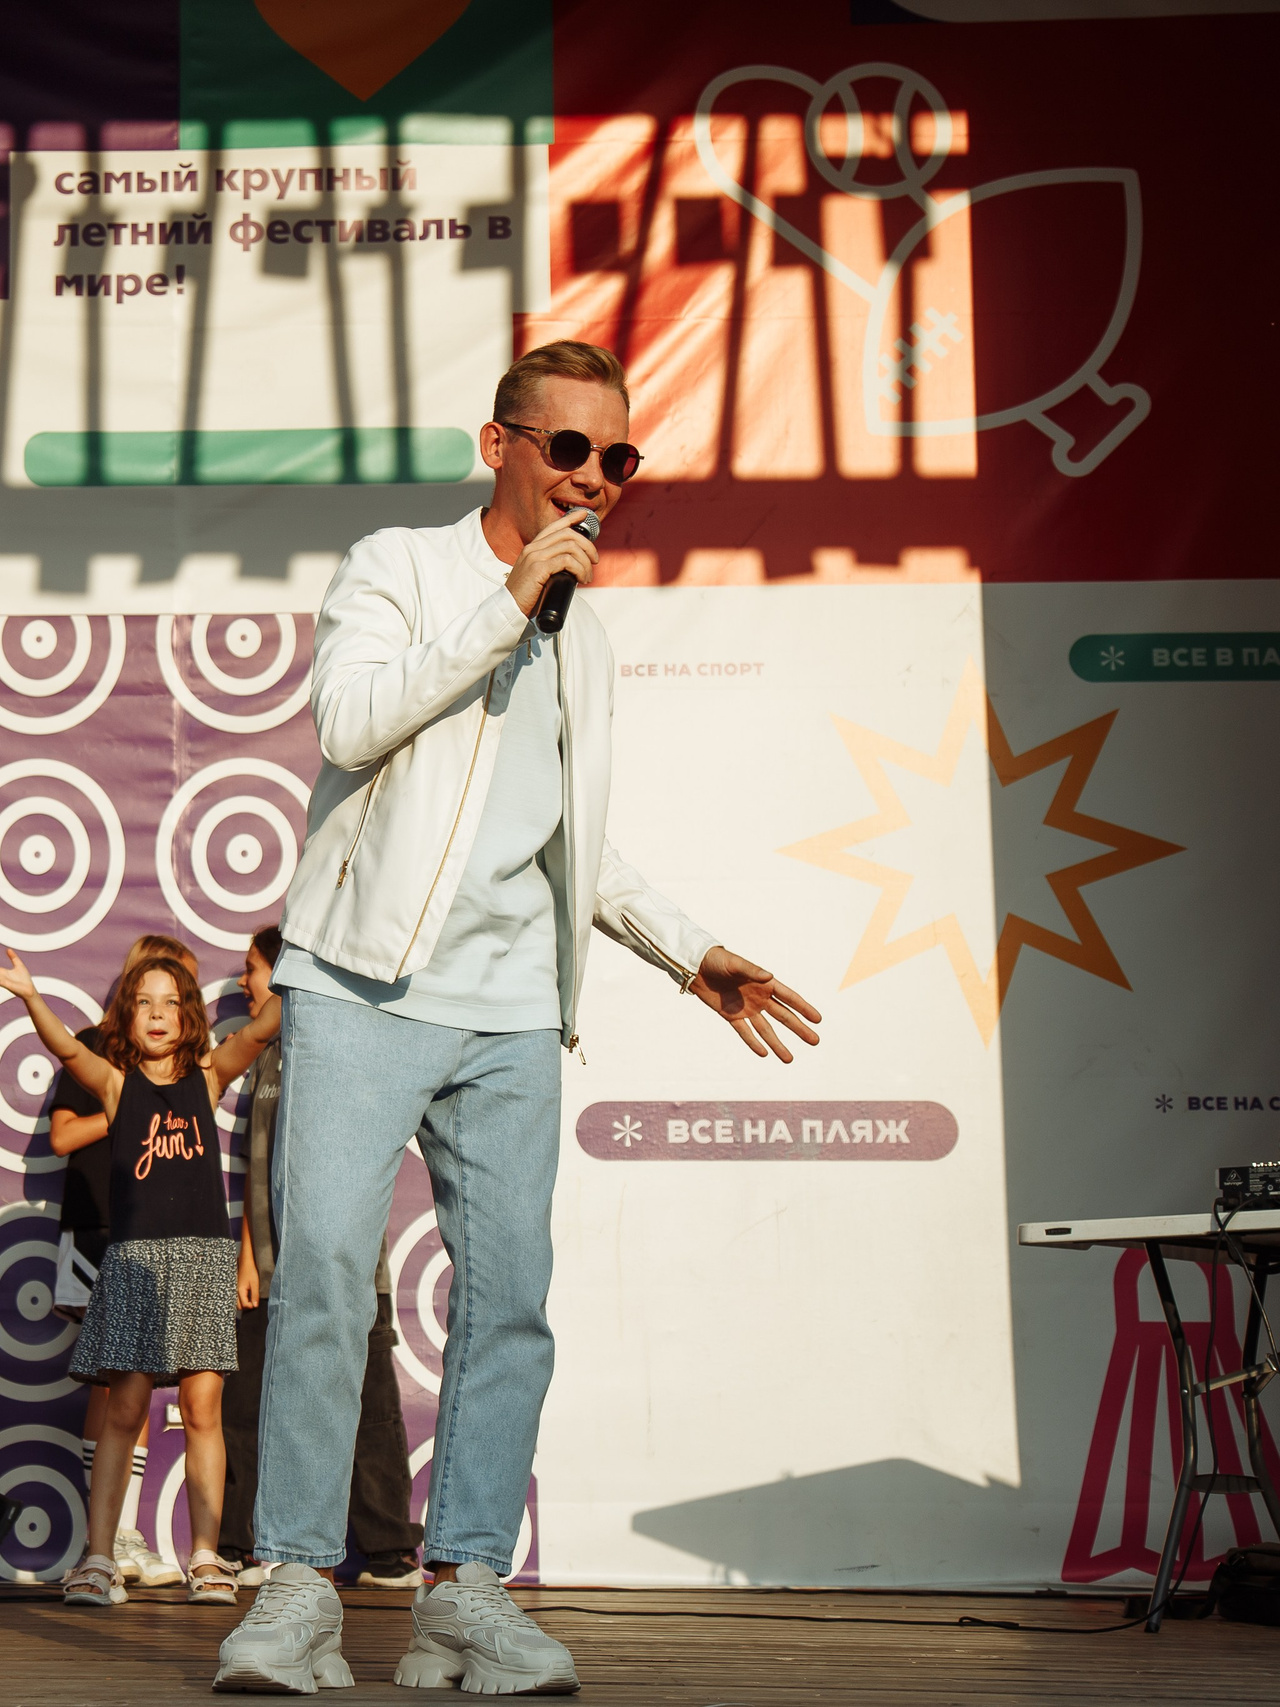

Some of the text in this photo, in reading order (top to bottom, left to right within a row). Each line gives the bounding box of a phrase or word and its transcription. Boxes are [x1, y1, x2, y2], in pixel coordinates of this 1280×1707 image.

[54, 160, 417, 200] самый крупный
[53, 213, 513, 252] летний фестиваль в
[54, 265, 186, 304] мире!
[620, 662, 765, 677] ВСЕ НА СПОРТ
[1152, 647, 1208, 667] ВСЕ
[1216, 647, 1234, 667] В
[1188, 1096, 1228, 1111] ВСЕ
[1234, 1096, 1264, 1111] НА
[667, 1118, 911, 1144] ВСЕ НА ПЛЯЖ
